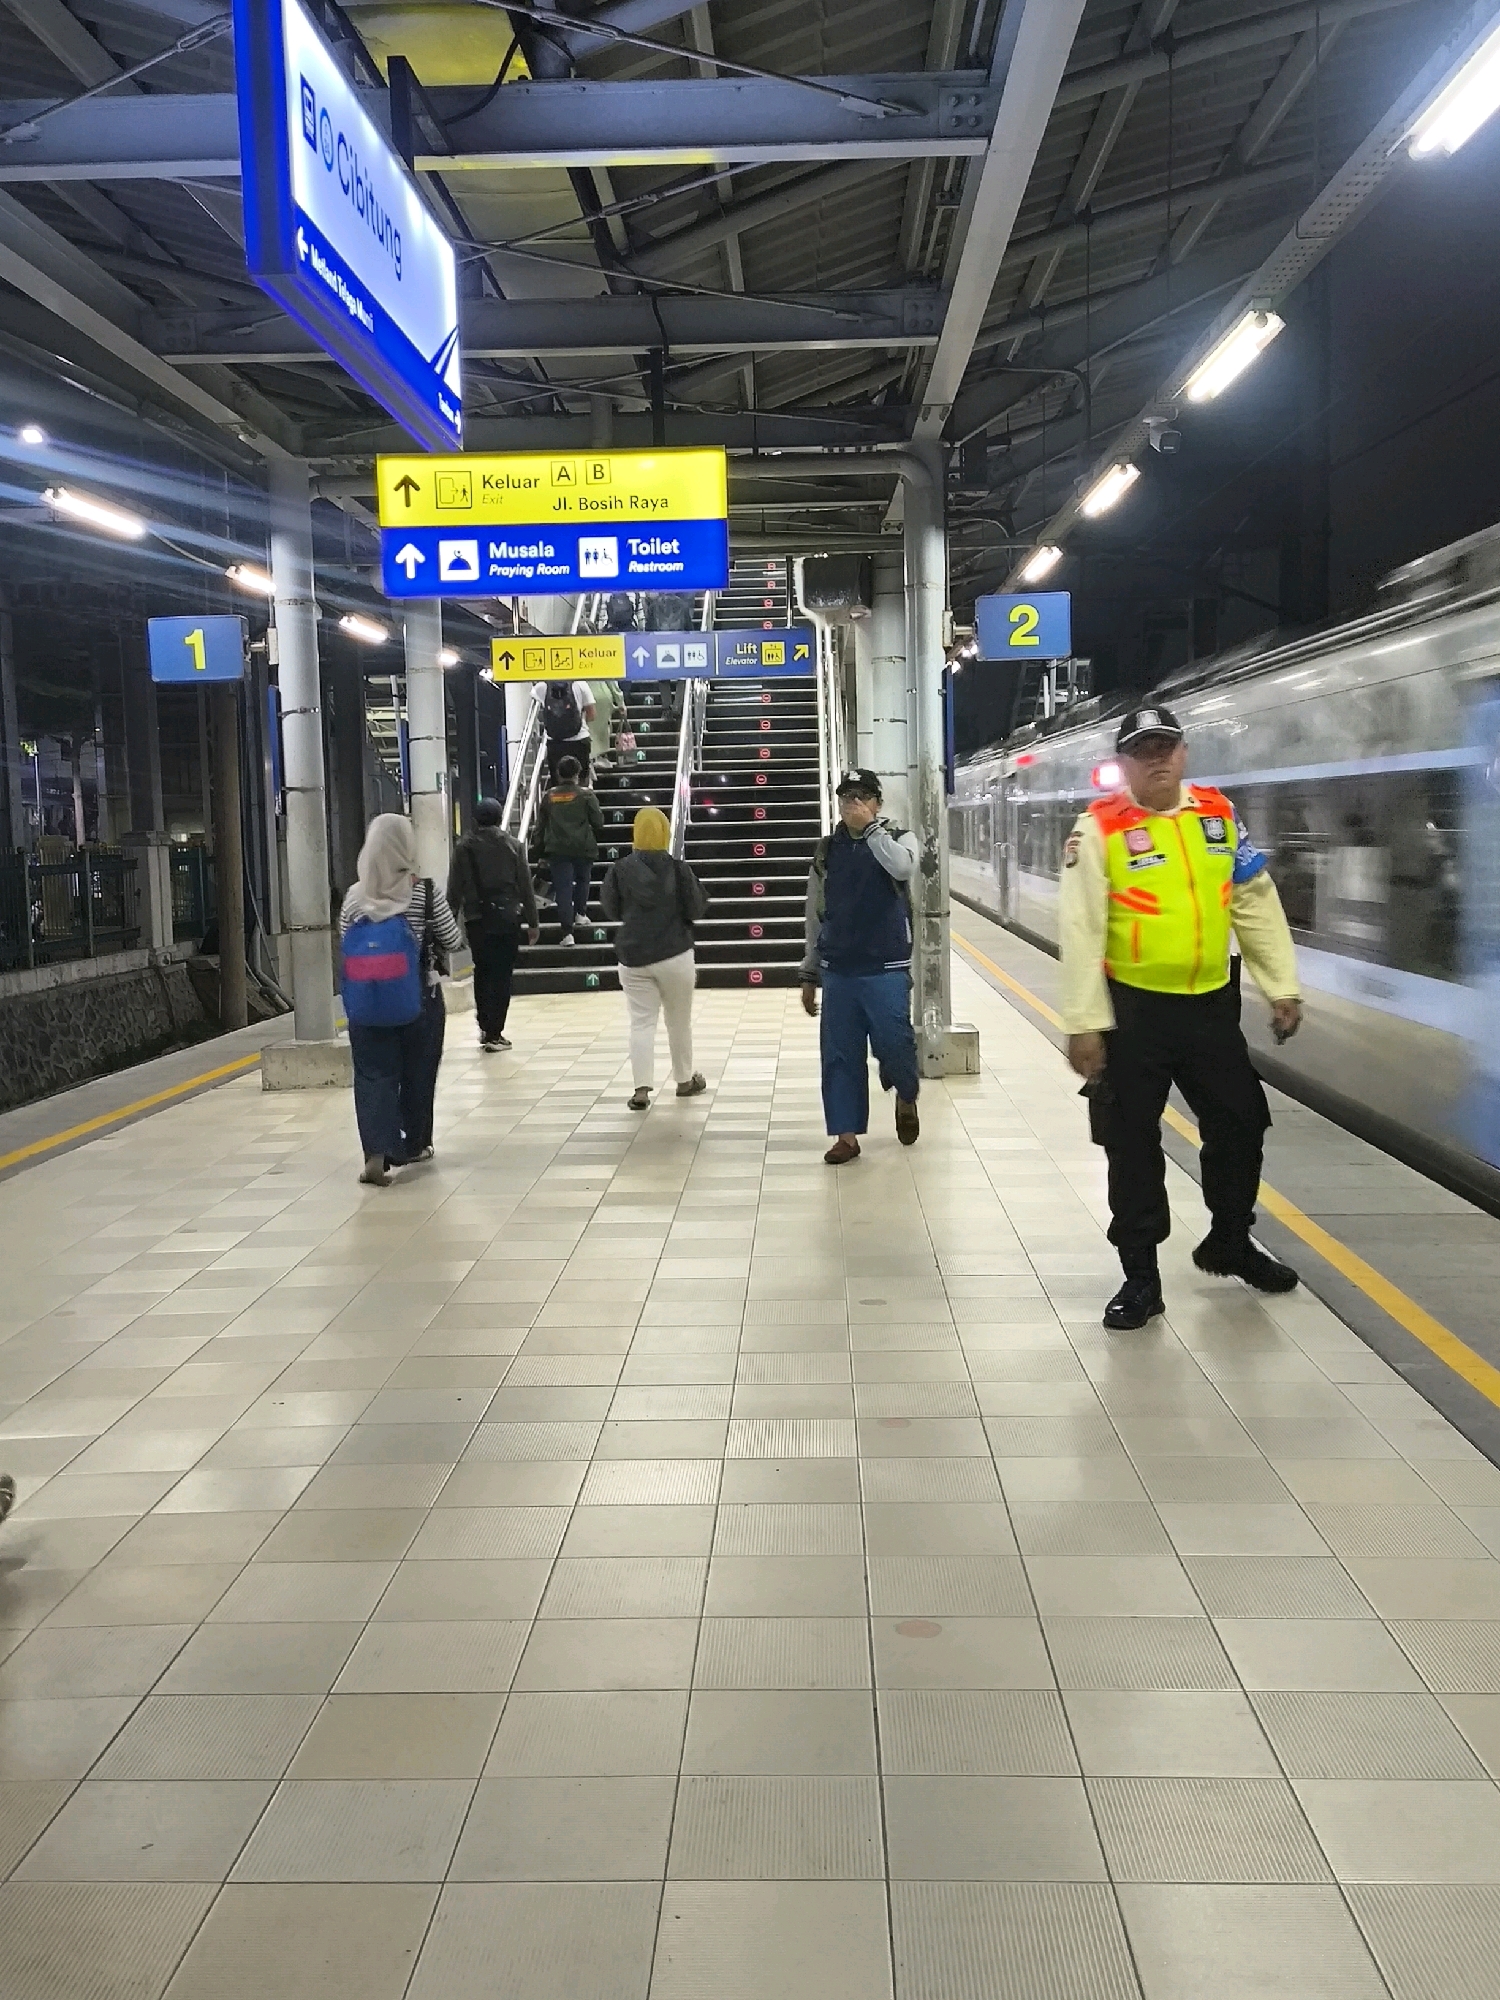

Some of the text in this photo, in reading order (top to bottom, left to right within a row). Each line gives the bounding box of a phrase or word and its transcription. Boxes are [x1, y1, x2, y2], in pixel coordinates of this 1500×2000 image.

[338, 131, 402, 282] Cibitung
[482, 463, 606, 490] Keluar A B
[482, 494, 504, 505] Exit
[552, 494, 670, 512] Jl. Bosih Raya
[489, 537, 681, 559] Musala Toilet
[489, 559, 684, 579] Praying Room Restroom
[1008, 603, 1040, 646] 2
[184, 628, 206, 670] 1
[578, 642, 758, 659] Keluar Lift
[578, 655, 758, 670] Exit Elevator
